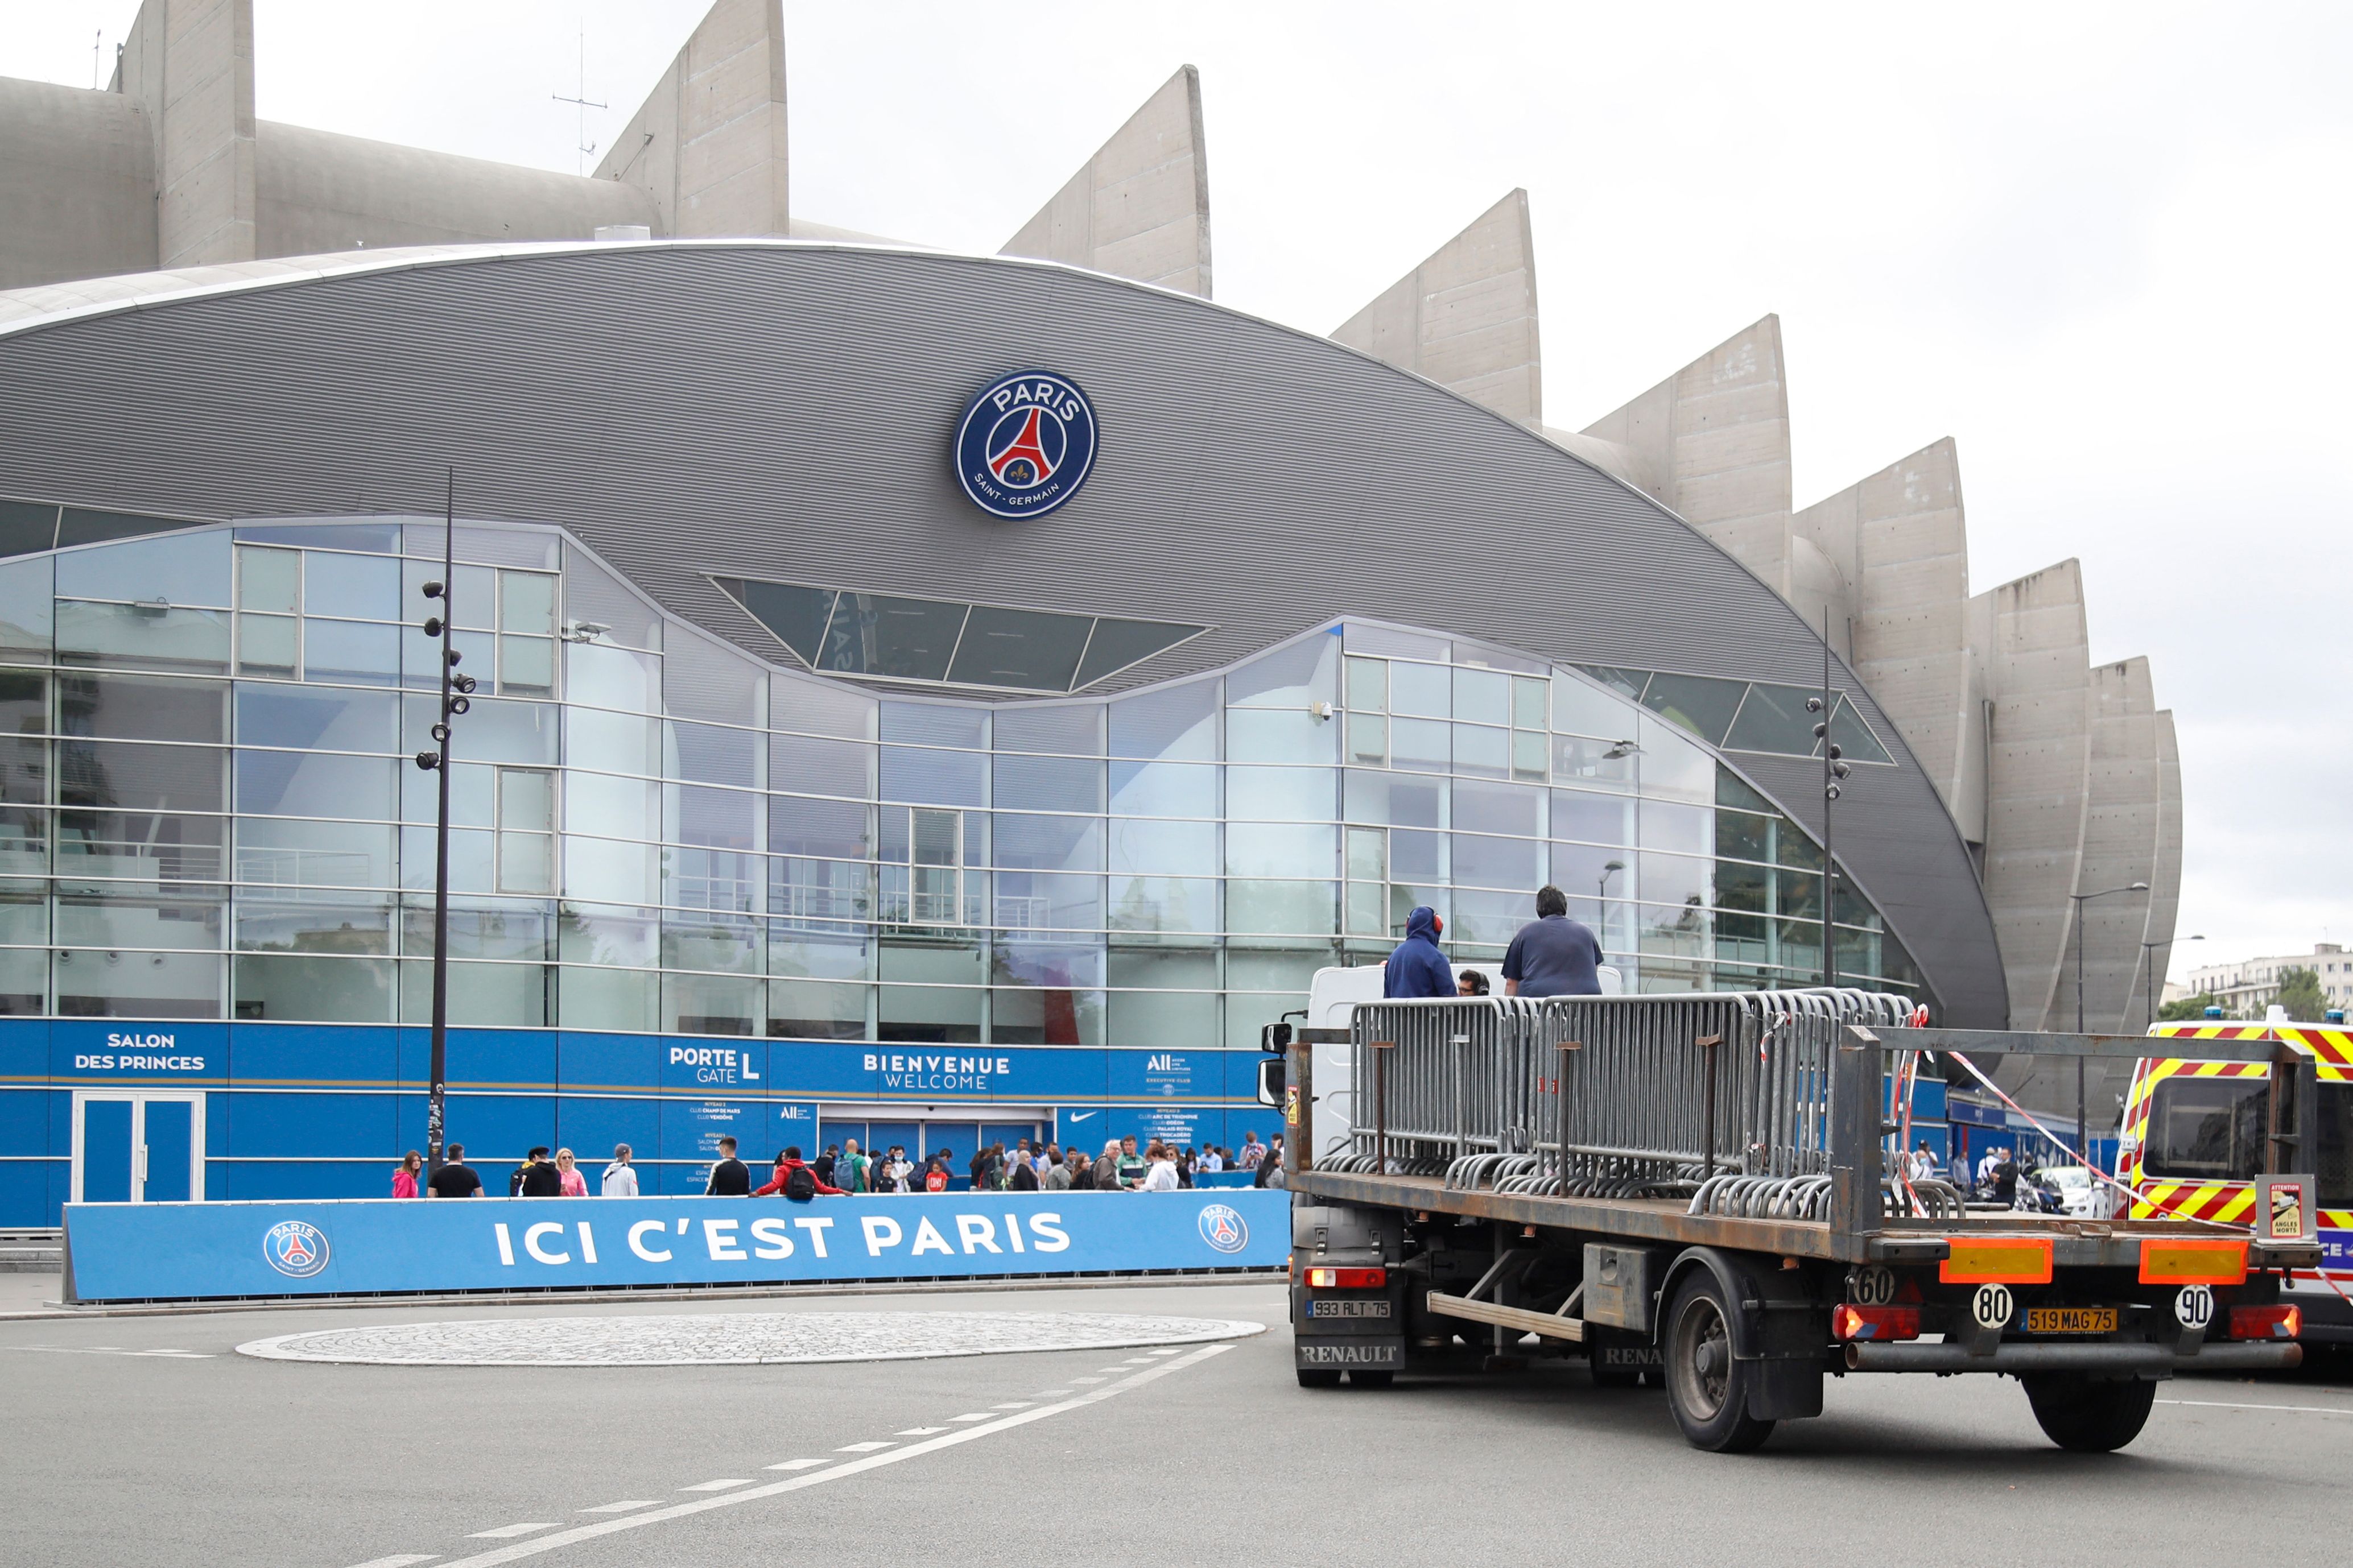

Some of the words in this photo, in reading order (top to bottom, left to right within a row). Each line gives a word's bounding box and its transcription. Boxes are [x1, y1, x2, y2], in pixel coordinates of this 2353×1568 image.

[993, 382, 1080, 421] PARIS
[108, 1033, 175, 1049] SALON
[75, 1054, 115, 1070] DES
[120, 1056, 205, 1071] PRINCES
[670, 1047, 737, 1066] PORTE
[864, 1054, 1010, 1074] BIENVENUE
[742, 1053, 760, 1079] L
[697, 1068, 737, 1083] GATE
[885, 1074, 987, 1090] WELCOME
[1203, 1207, 1235, 1219] PARIS
[273, 1223, 315, 1238] PARIS
[494, 1221, 598, 1265] ICI
[628, 1216, 834, 1263] C'EST
[860, 1212, 1071, 1257] PARIS
[1858, 1269, 1893, 1304] 60
[1315, 1302, 1339, 1316] 933
[1373, 1302, 1388, 1315] 75
[1979, 1289, 2007, 1322] 80
[2182, 1289, 2208, 1324] 90
[2029, 1311, 2058, 1330] 519
[2061, 1311, 2090, 1330] MAG
[2093, 1311, 2112, 1330] 75
[1300, 1346, 1397, 1363] RENAULT
[1604, 1348, 1665, 1364] RENA
